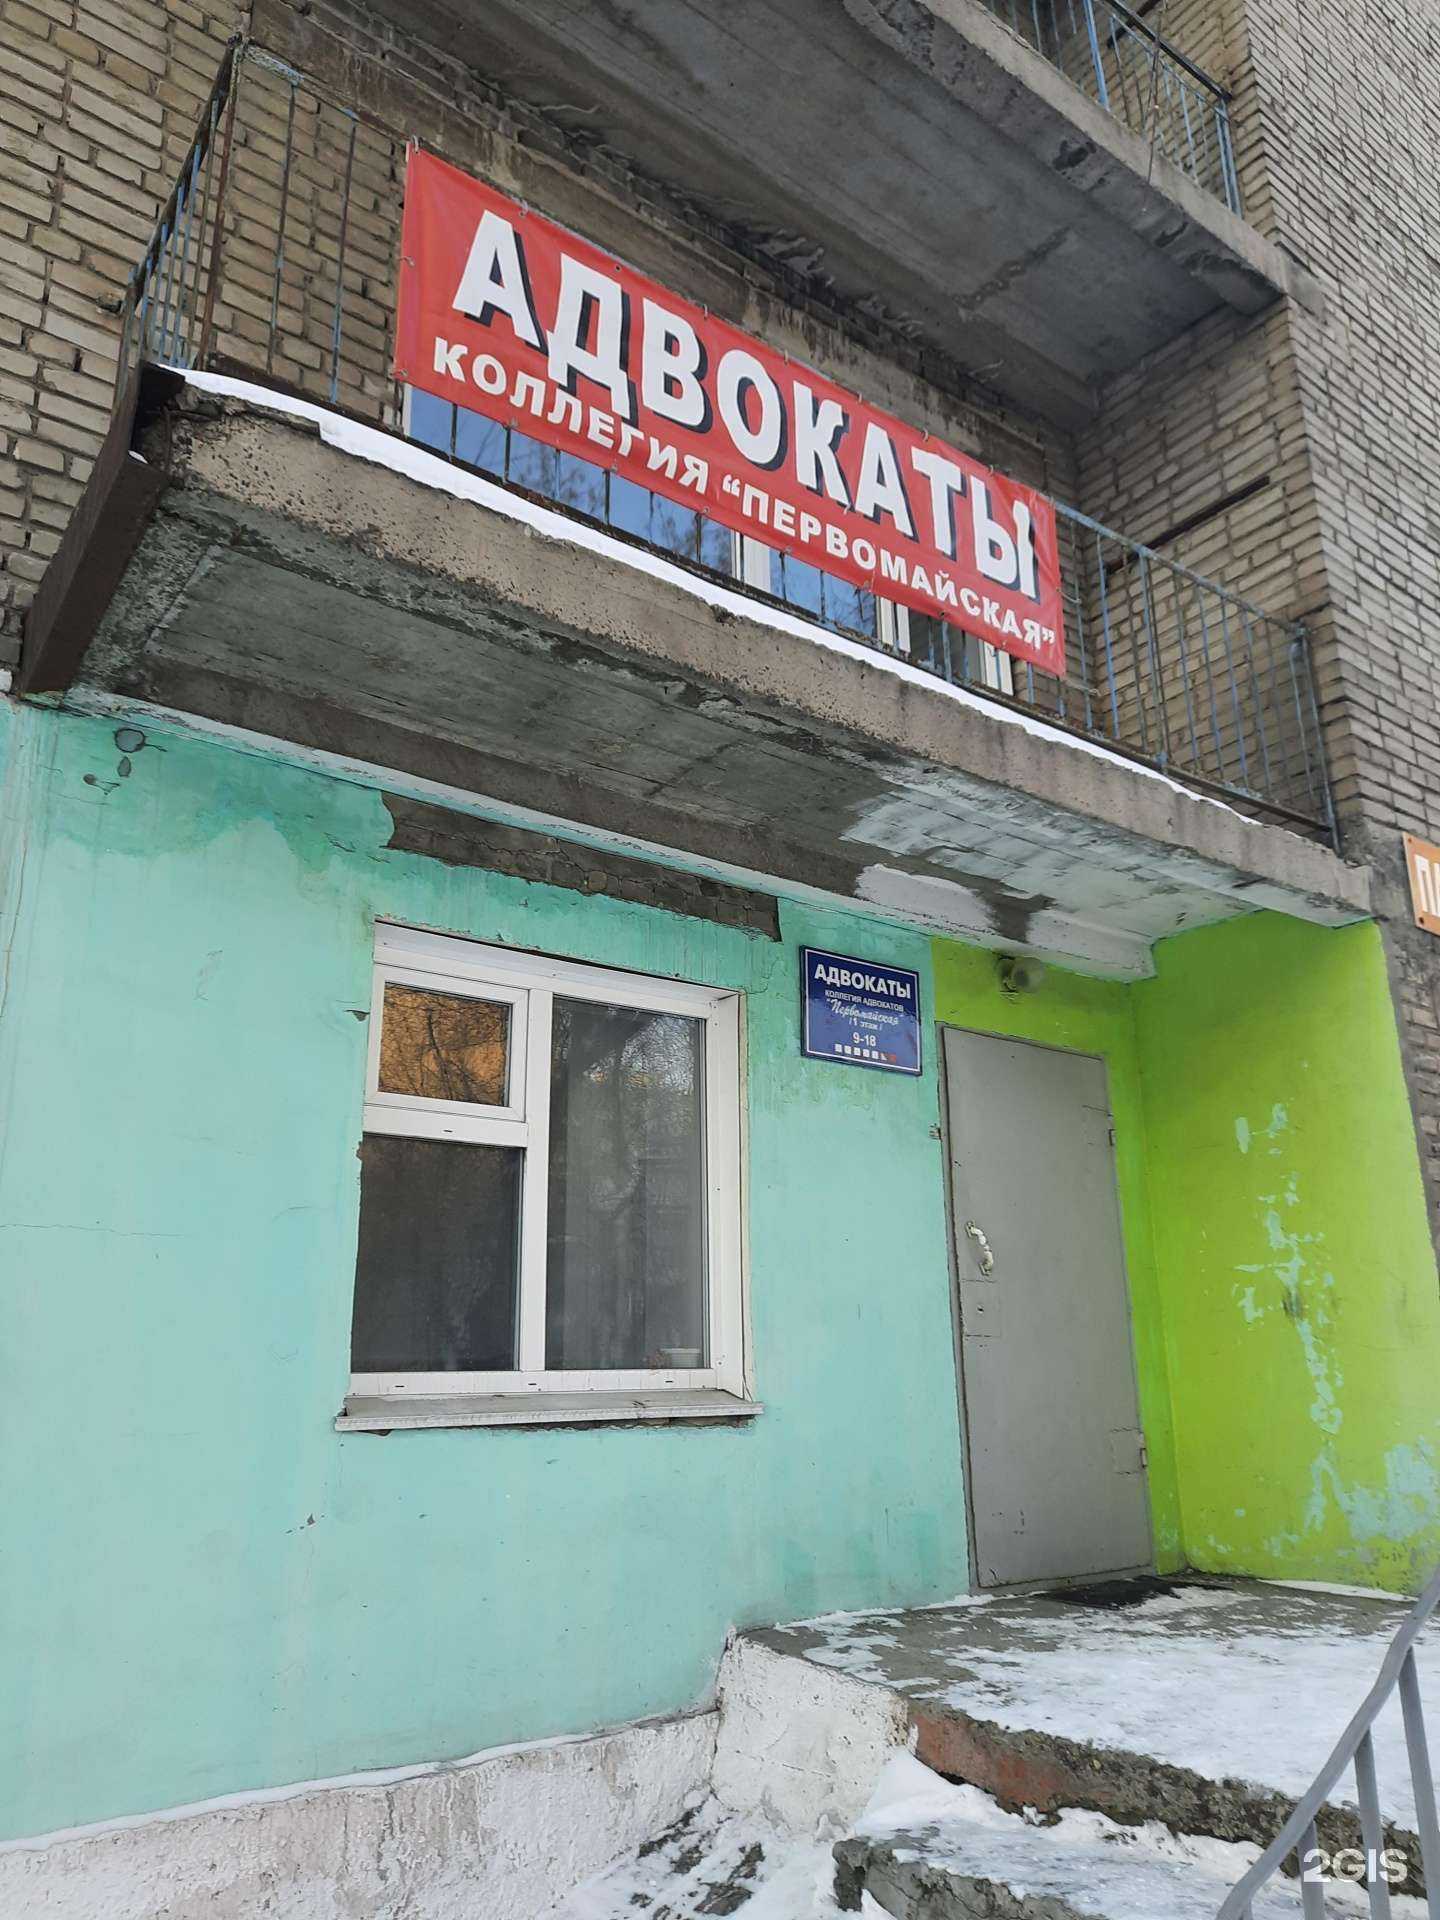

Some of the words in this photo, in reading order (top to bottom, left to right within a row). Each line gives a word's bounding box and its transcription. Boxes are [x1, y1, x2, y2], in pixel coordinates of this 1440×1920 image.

[433, 337, 709, 494] КОЛЛЕГИЯ
[452, 209, 1040, 603] АДВОКАТЫ
[814, 964, 911, 999] АДВОКАТЫ
[825, 989, 862, 1003] КОЛЛЕГИЯ
[863, 997, 904, 1011] АДВОКАТОВ
[852, 1031, 877, 1047] 9-18
